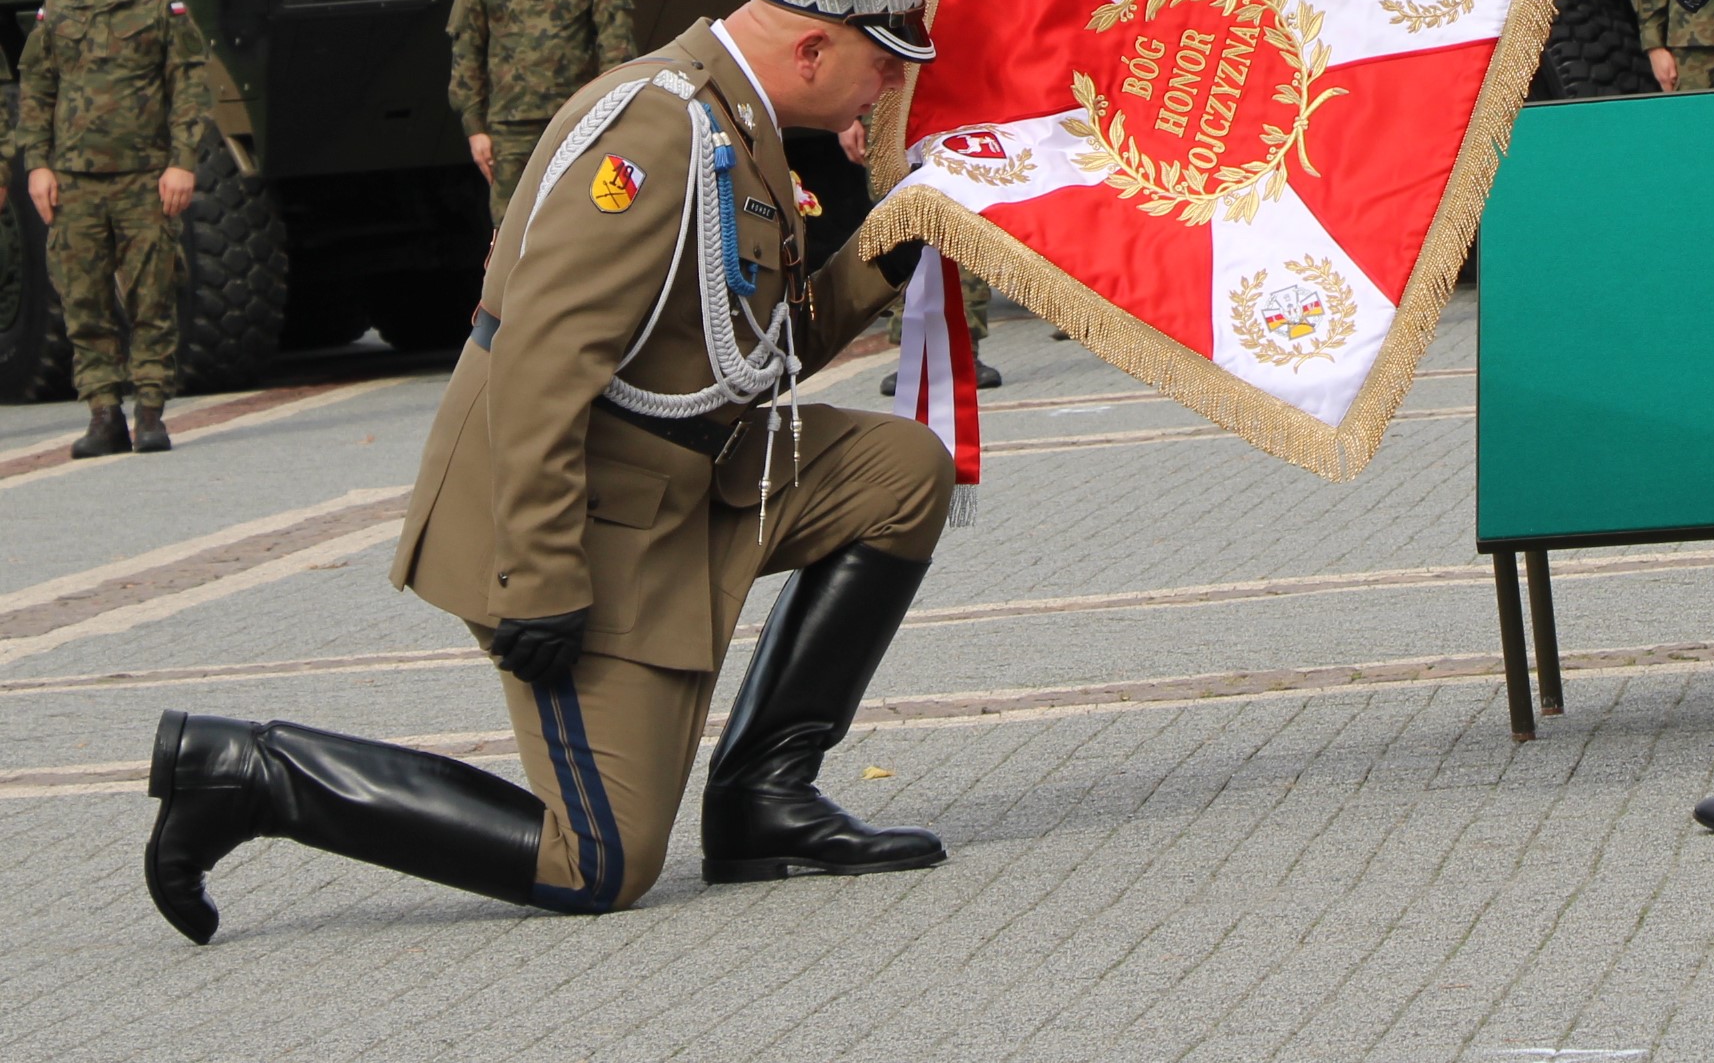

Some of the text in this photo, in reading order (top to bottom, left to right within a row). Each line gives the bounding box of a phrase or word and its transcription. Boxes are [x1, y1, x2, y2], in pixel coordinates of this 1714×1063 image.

[1121, 36, 1166, 101] BÓG
[1155, 29, 1215, 138] HONOR
[1188, 26, 1260, 169] OJCZYZNA
[609, 162, 634, 190] 19
